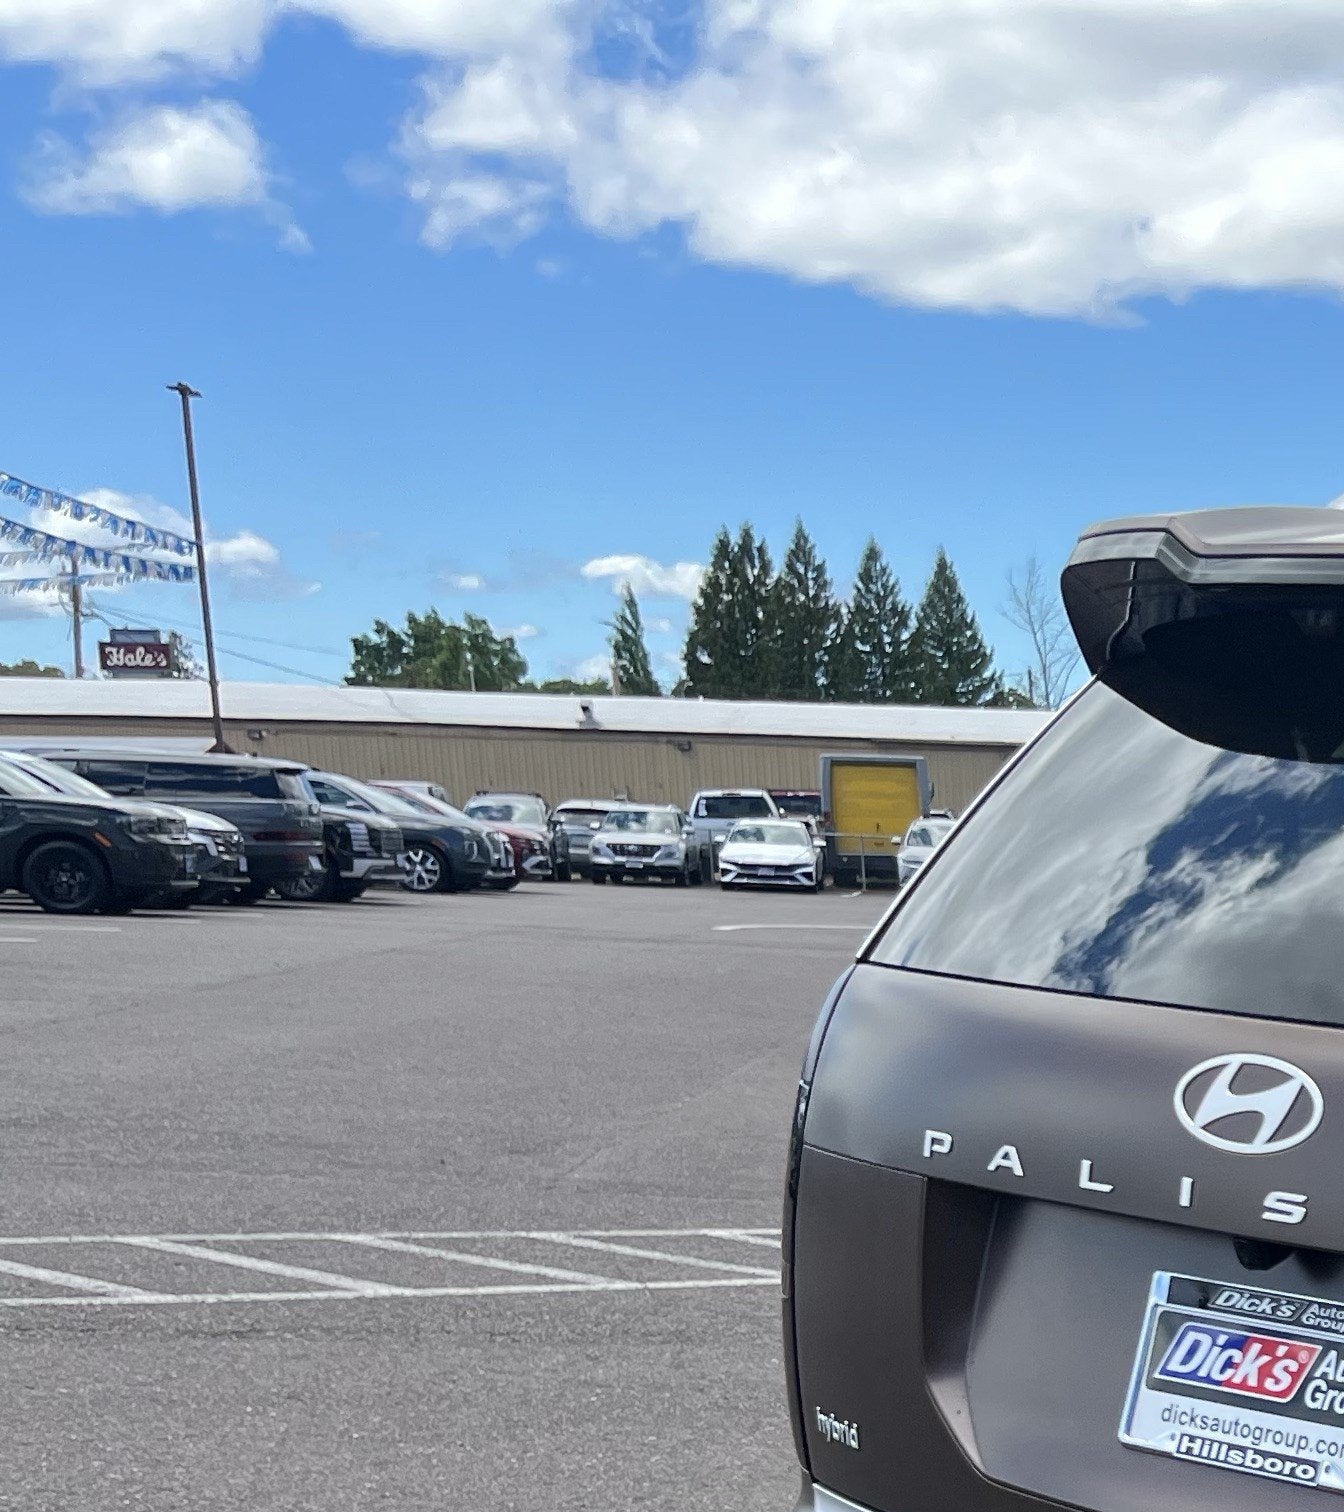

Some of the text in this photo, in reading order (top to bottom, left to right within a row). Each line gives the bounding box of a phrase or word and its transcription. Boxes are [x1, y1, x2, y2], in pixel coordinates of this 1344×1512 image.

[105, 646, 167, 667] Hale's
[1214, 1289, 1297, 1318] Dick's
[1165, 1330, 1300, 1393] Dick's
[1178, 1433, 1317, 1480] Hillsboro
